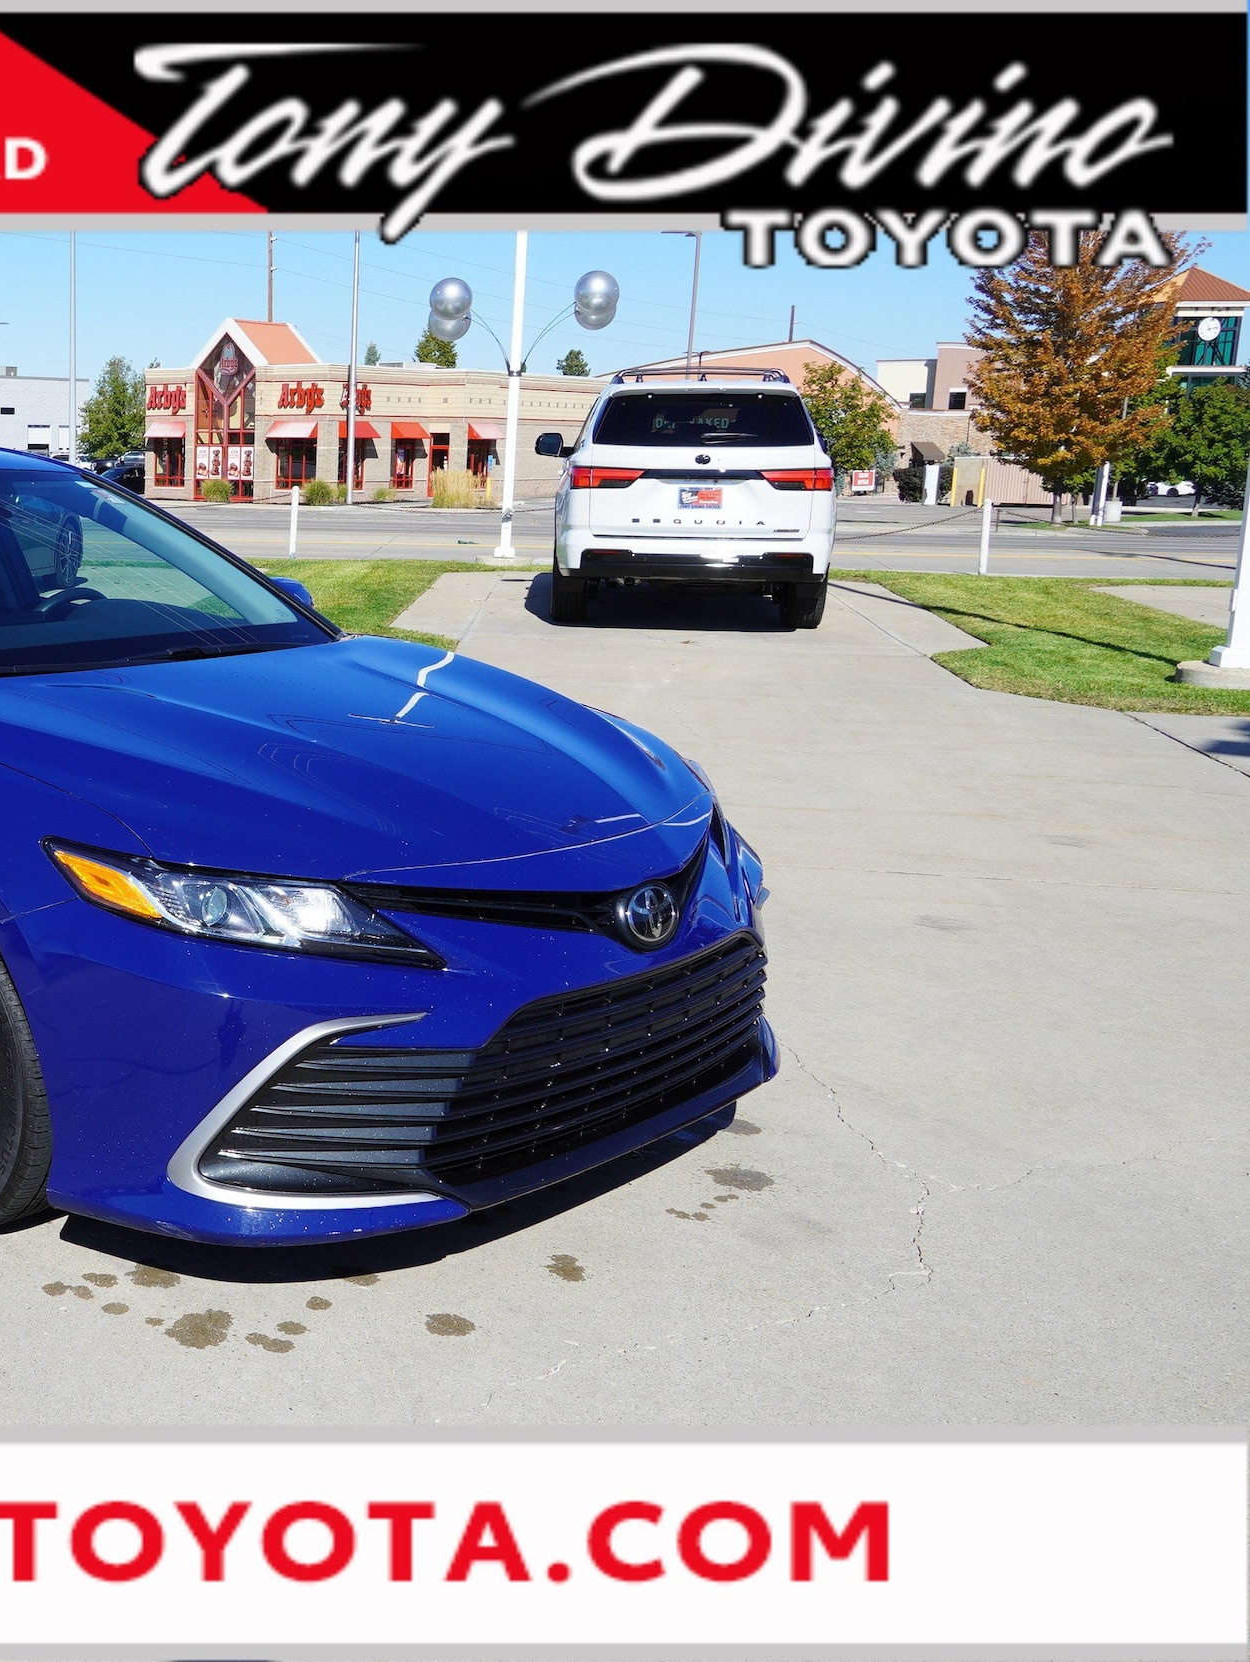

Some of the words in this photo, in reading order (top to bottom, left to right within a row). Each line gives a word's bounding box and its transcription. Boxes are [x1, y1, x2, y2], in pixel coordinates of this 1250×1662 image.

[147, 383, 186, 416] Arby's
[278, 381, 325, 415] Arby's
[631, 518, 765, 526] SEQUOIA
